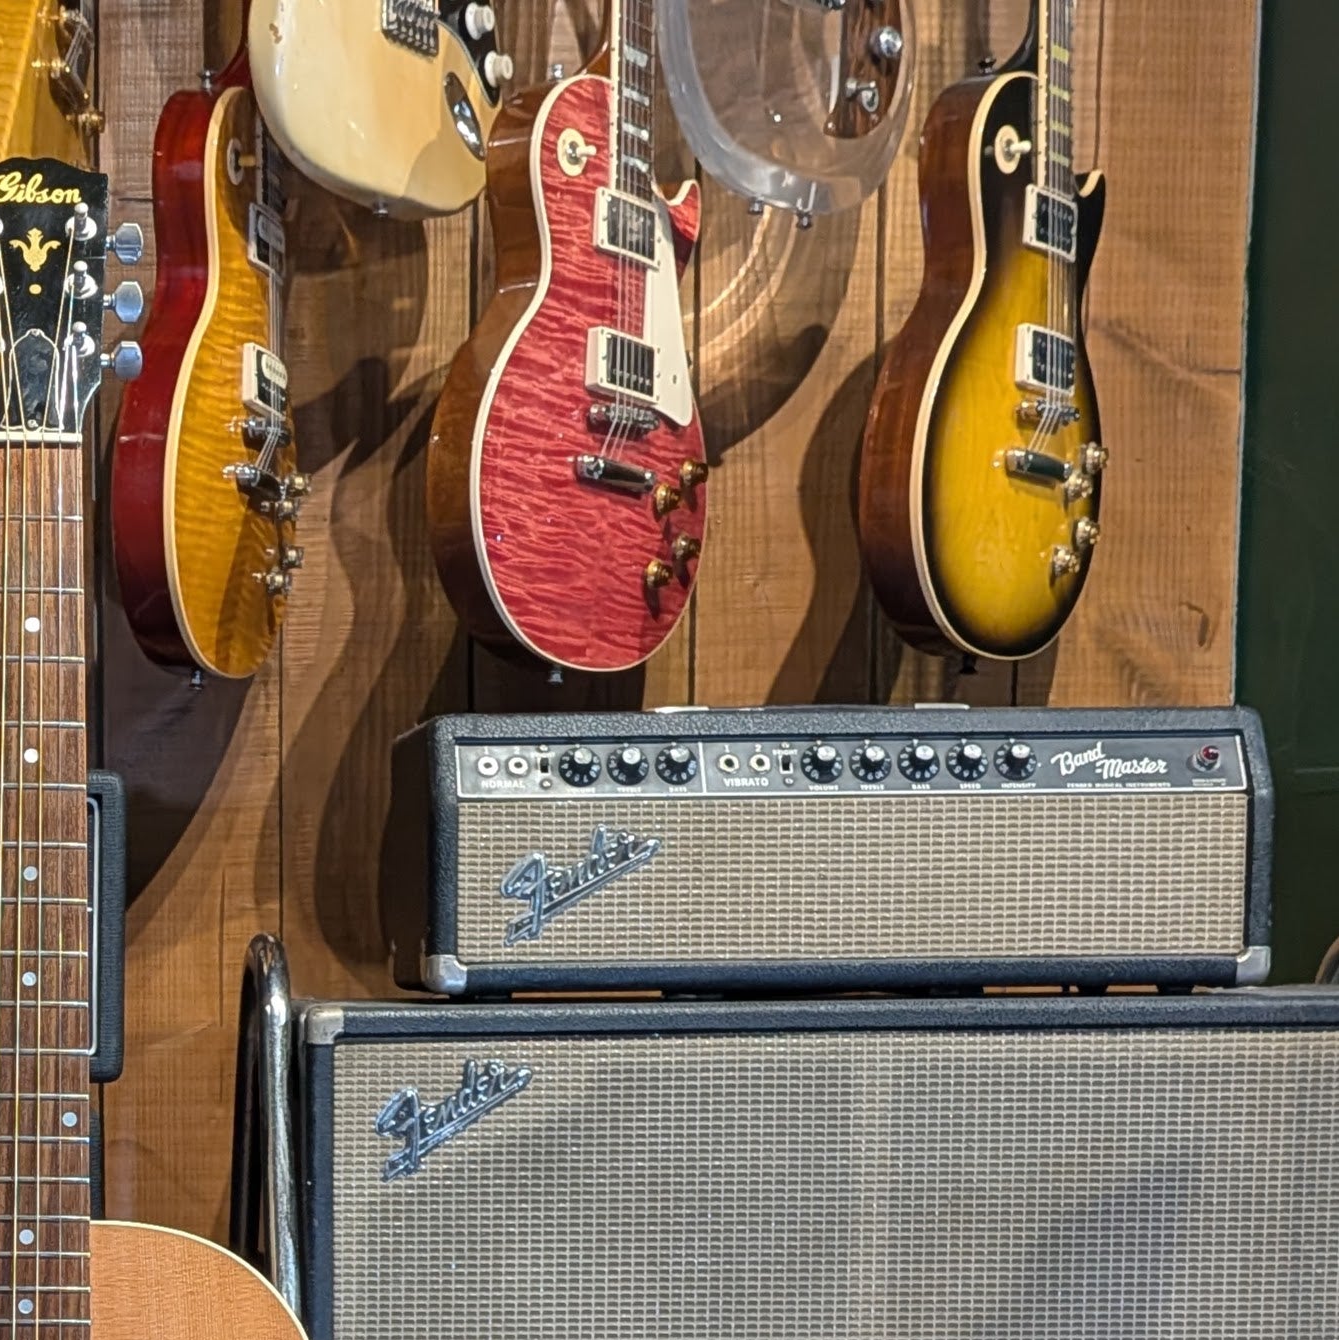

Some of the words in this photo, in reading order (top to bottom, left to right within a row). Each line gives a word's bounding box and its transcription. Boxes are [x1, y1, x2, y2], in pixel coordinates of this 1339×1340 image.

[755, 743, 762, 753] 2
[1050, 741, 1106, 776] Band
[480, 780, 526, 790] NORMAL
[723, 777, 769, 787] VIBRATO
[501, 823, 660, 946] Fender
[376, 1058, 533, 1183] Fender
